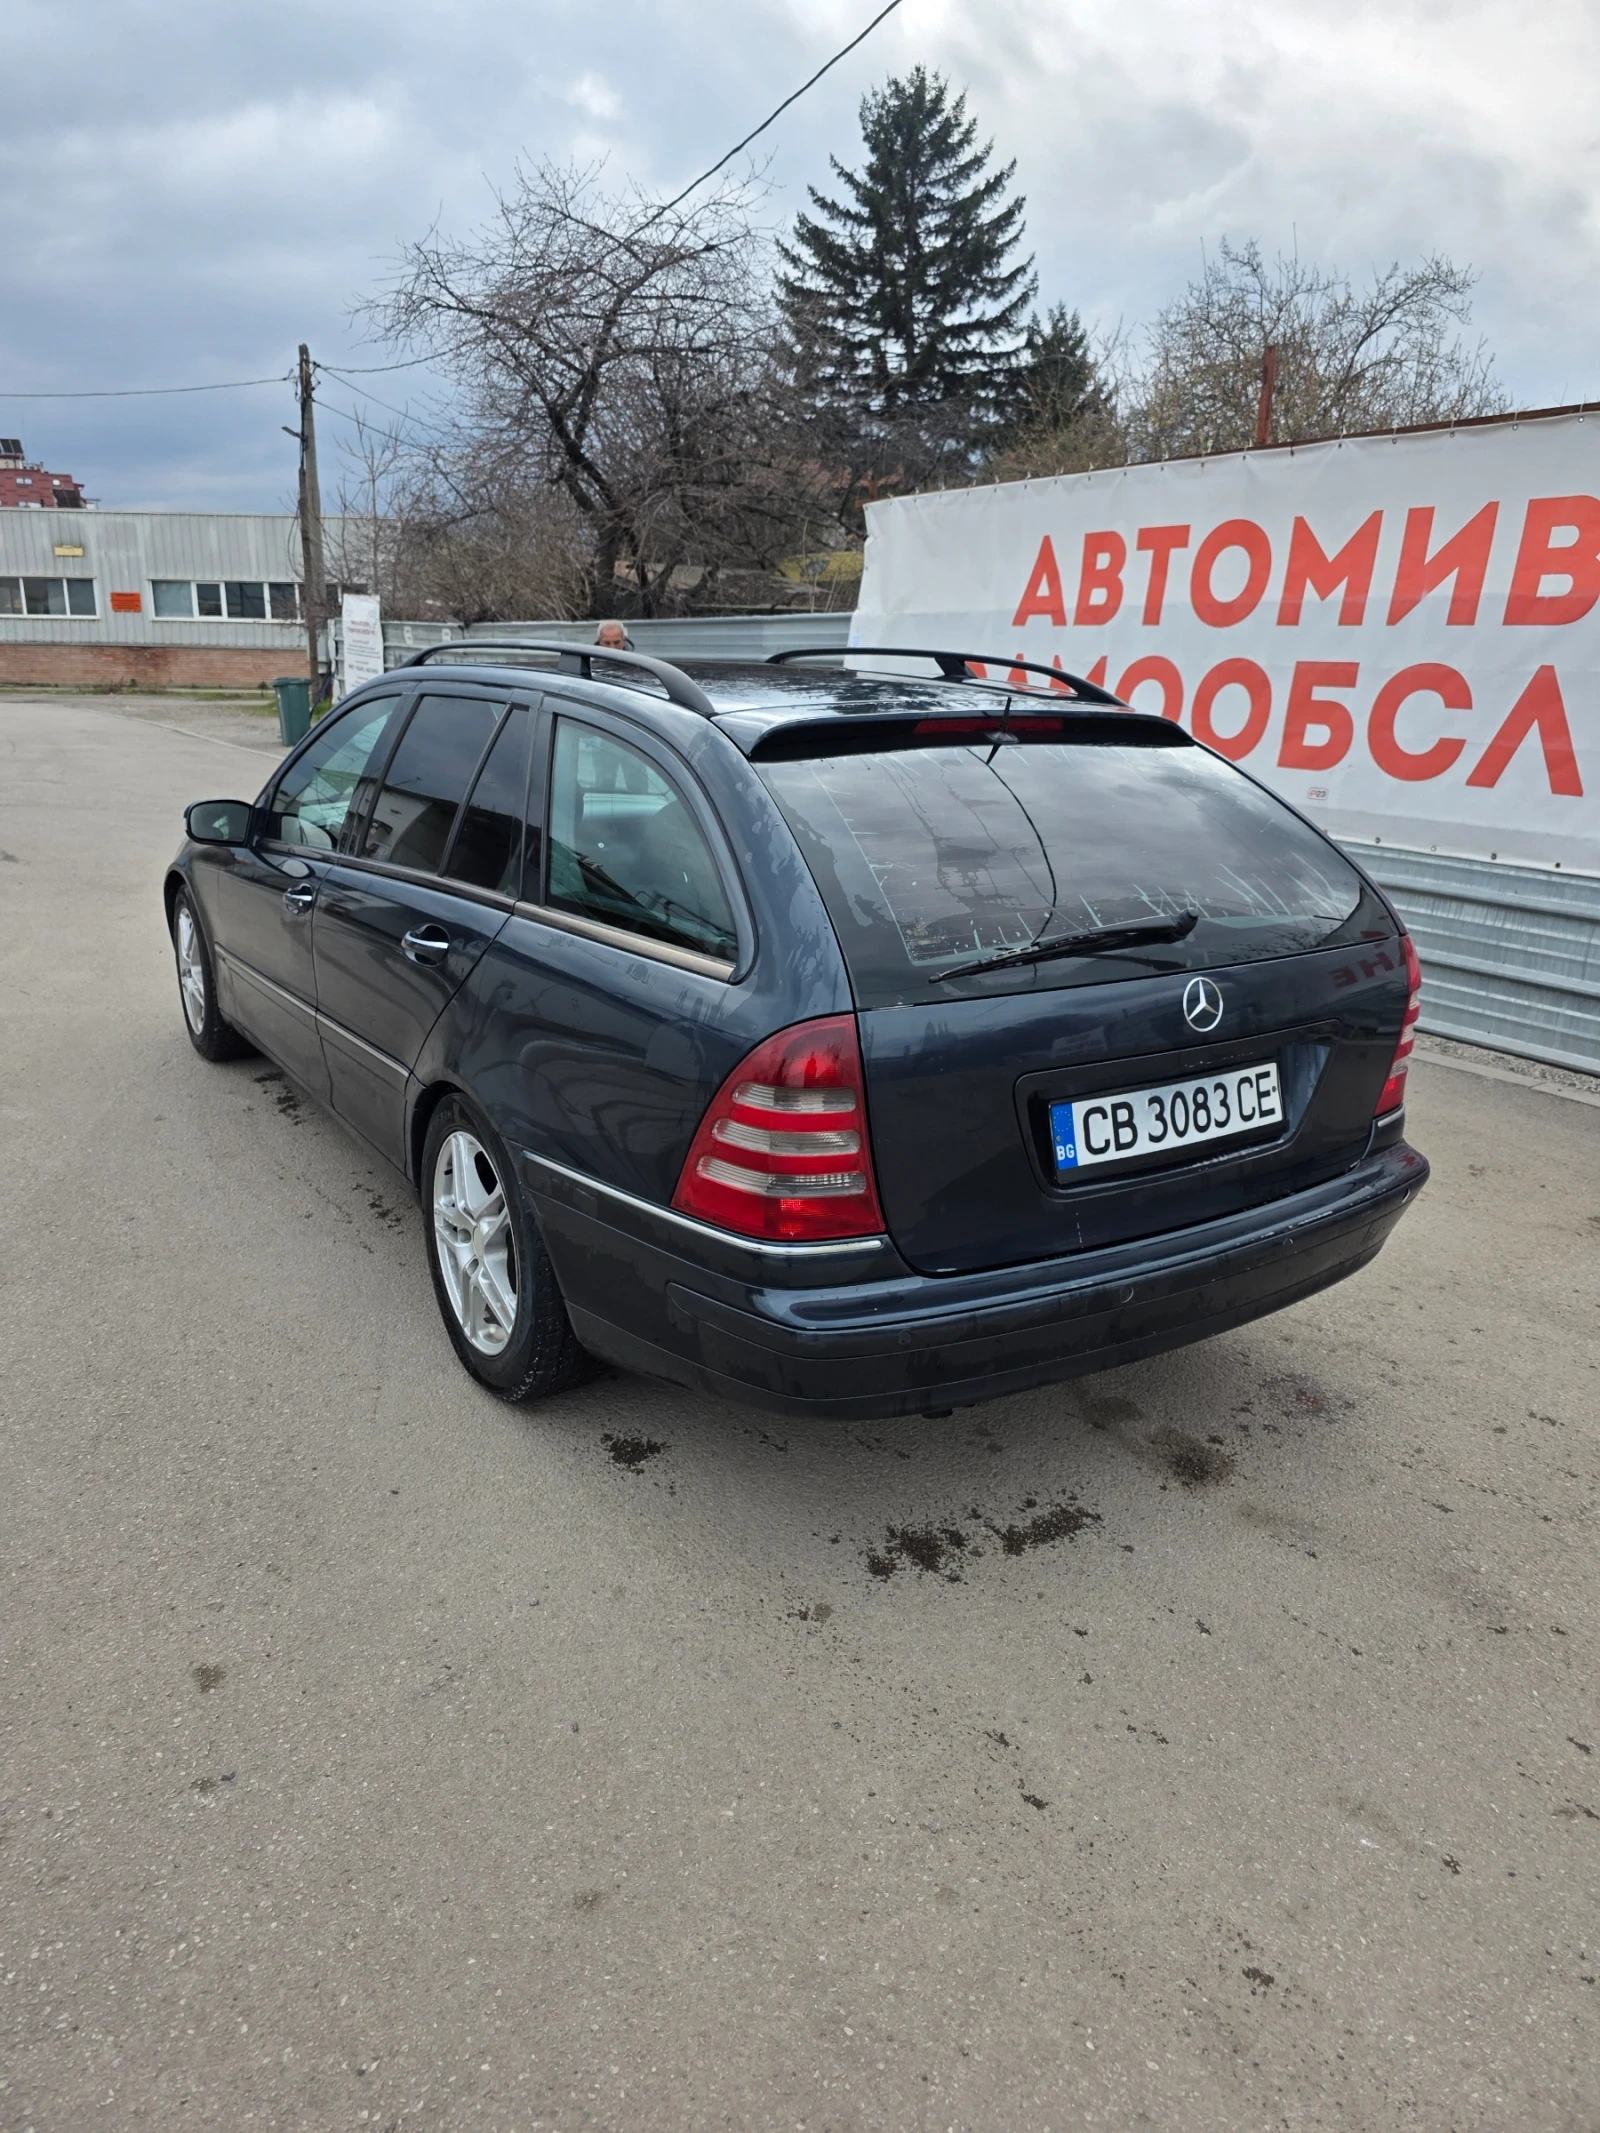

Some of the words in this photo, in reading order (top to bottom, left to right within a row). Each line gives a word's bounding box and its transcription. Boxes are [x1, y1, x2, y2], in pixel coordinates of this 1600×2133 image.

[1012, 495, 1600, 627] АВТОМИВ
[1057, 1144, 1075, 1161] BG
[1083, 1101, 1138, 1156] CB
[1148, 1082, 1231, 1144] 3083
[1237, 1070, 1276, 1122] CE
